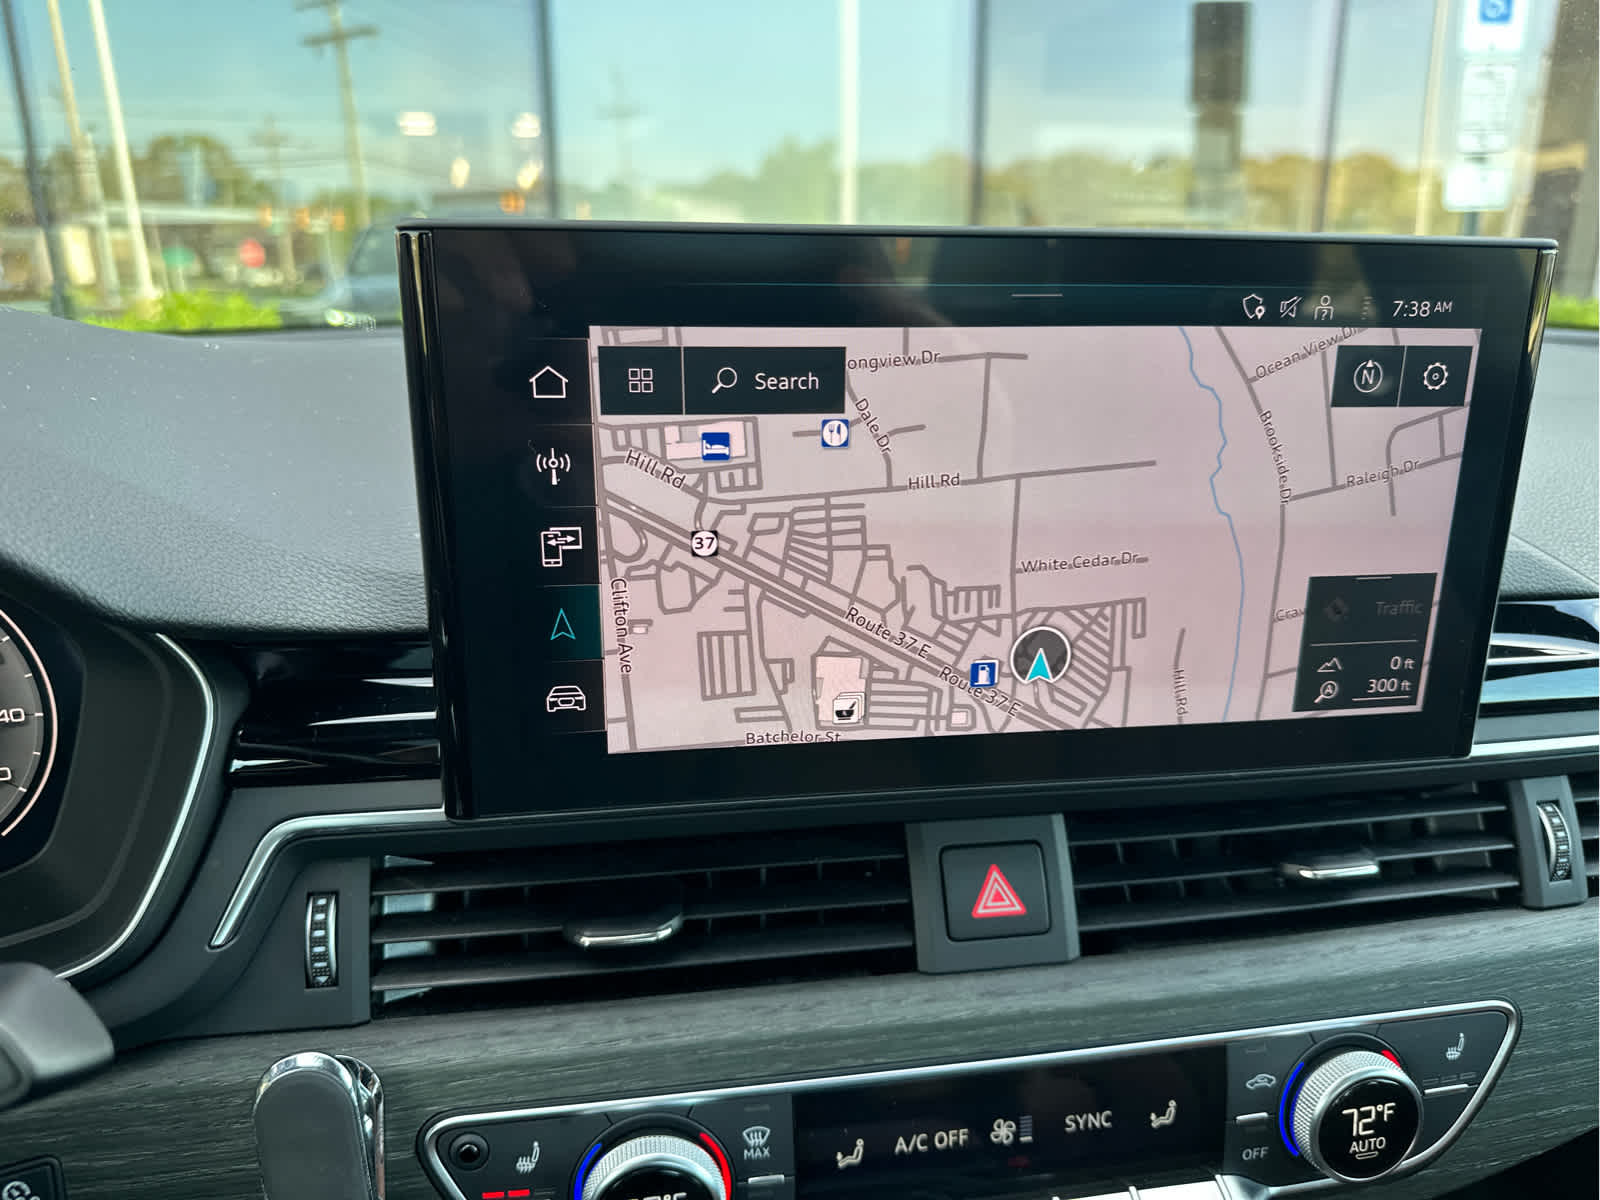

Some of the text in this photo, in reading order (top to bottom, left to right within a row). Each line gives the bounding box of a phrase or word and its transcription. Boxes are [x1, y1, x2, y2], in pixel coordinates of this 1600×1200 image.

[1393, 300, 1453, 317] 7:38 AM
[847, 350, 941, 373] ongview Dr
[1254, 350, 1302, 379] Ocean
[1303, 335, 1340, 357] View
[754, 372, 820, 391] Search
[855, 398, 892, 453] Dale Dr
[625, 448, 687, 489] Hill Rd
[1259, 410, 1292, 505] Brookside Dr
[907, 473, 961, 490] Hill Rd
[1346, 459, 1420, 488] Raleigh Dr
[694, 536, 715, 550] 37
[1021, 551, 1139, 573] White Cedar Dr
[1375, 601, 1424, 617] Traffic
[610, 578, 634, 673] Clifton Ave
[844, 606, 932, 660] Route 37 E
[1389, 655, 1416, 670] 0 ft
[1173, 669, 1189, 716] Hill Rd
[1366, 677, 1412, 694] 300 ft
[984, 688, 1009, 710] 37
[1007, 702, 1023, 718] E
[745, 730, 841, 745] Batchelor St
[1065, 1111, 1112, 1132] SYNC
[1342, 1102, 1396, 1136] 72°F
[894, 1128, 969, 1156] A/C OFF
[1349, 1136, 1386, 1153] AUTO
[743, 1148, 771, 1160] MAX
[1242, 1147, 1268, 1161] OFF
